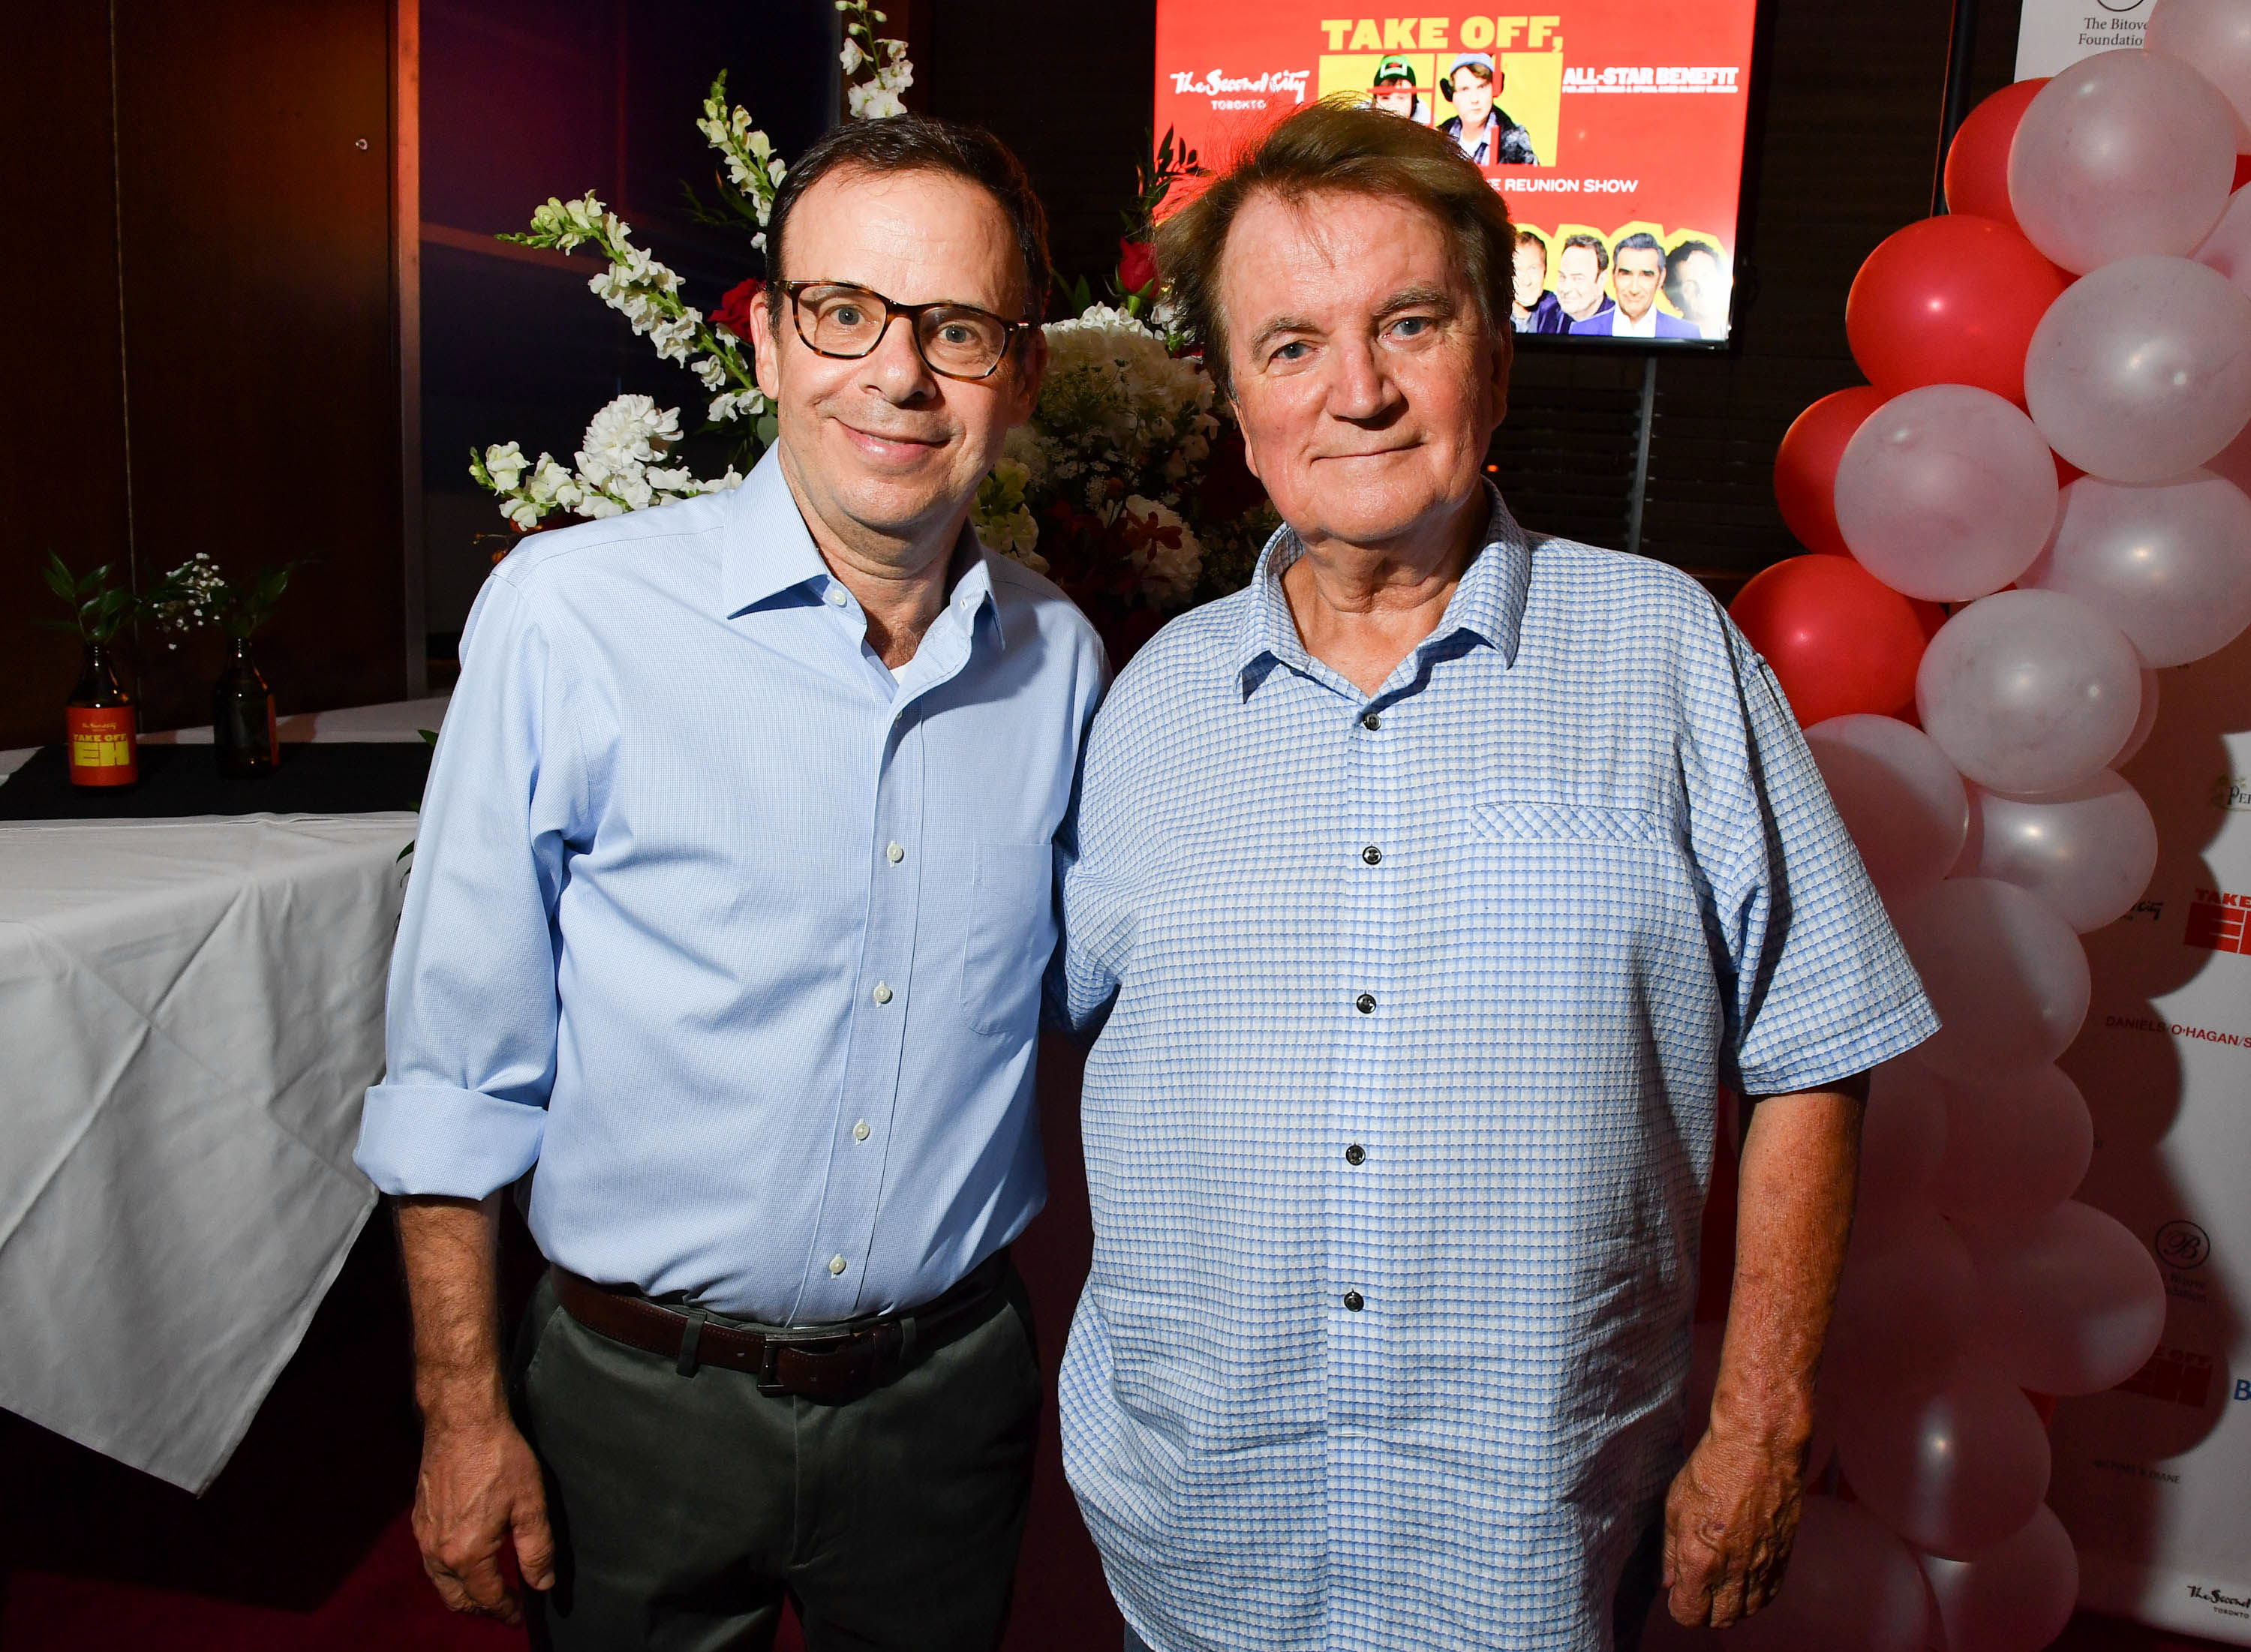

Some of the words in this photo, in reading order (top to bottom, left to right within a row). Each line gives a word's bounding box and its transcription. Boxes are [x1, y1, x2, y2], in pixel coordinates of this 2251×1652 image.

[2084, 17, 2107, 30] The
[1321, 17, 1450, 50] TAKE
[1459, 15, 1563, 53] OFF,
[2078, 33, 2144, 46] Foundatio
[1562, 67, 1654, 86] ALL-STAR
[1655, 67, 1739, 86] BENEFIT
[1170, 71, 1208, 95] The
[1206, 68, 1269, 96] Second
[1269, 70, 1310, 104] City
[1210, 100, 1267, 110] TORONTO
[1504, 178, 1580, 192] REUNION
[1583, 179, 1639, 193] SHOW
[74, 734, 102, 742] TAKE
[104, 733, 127, 742] OFF
[2194, 888, 2251, 908] TAKE
[2186, 1585, 2210, 1600] The
[2213, 1606, 2249, 1619] TORONTO
